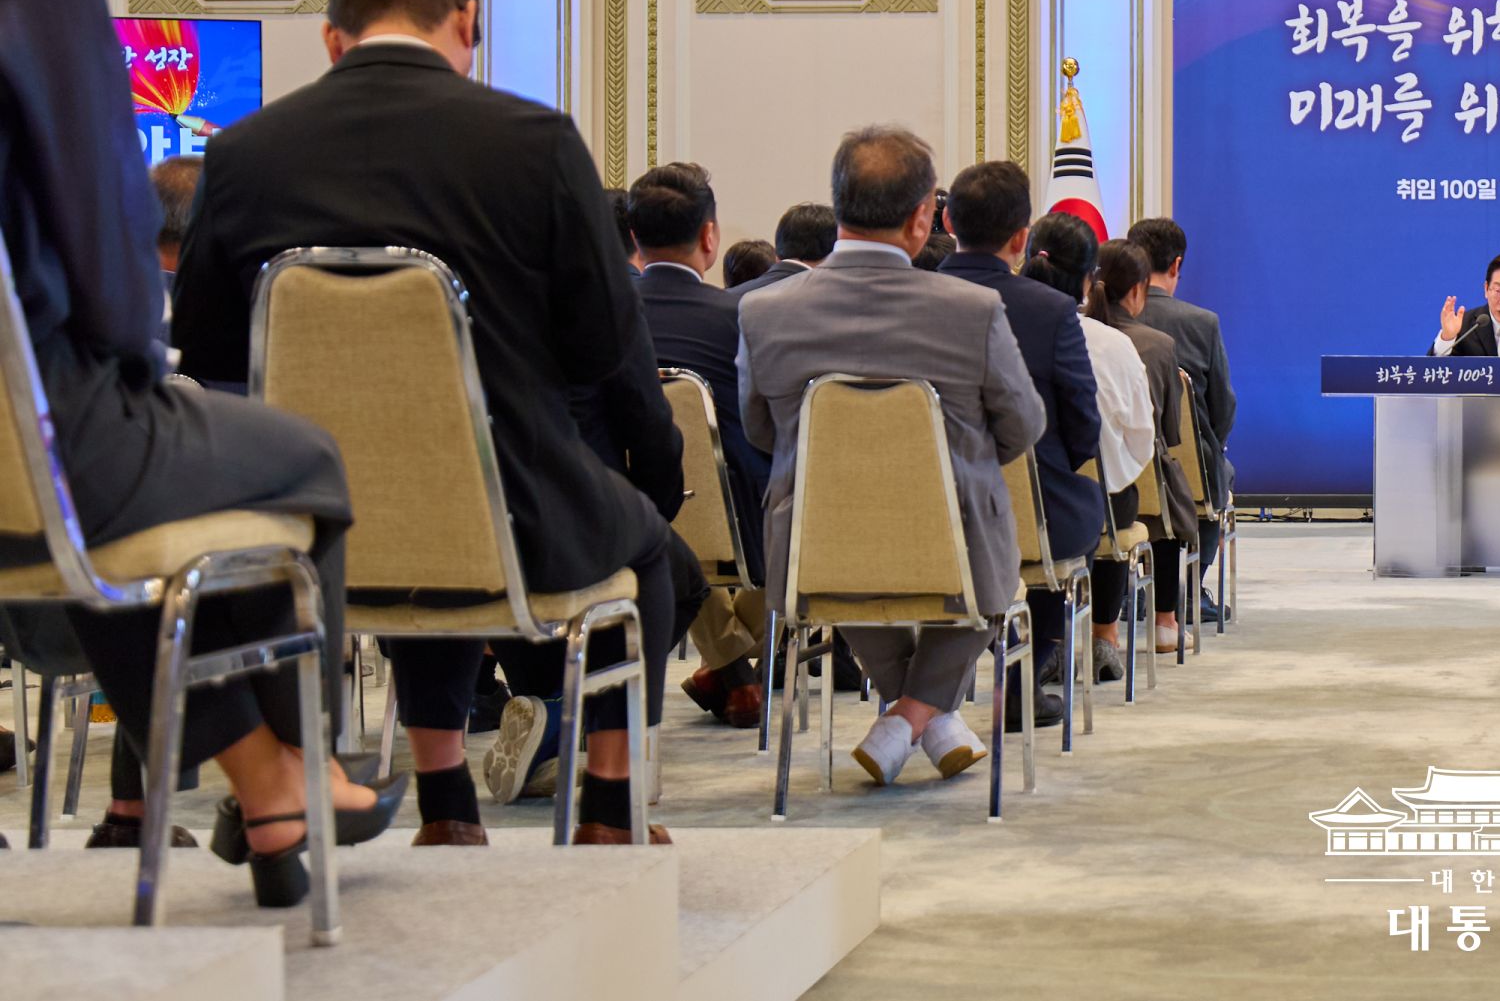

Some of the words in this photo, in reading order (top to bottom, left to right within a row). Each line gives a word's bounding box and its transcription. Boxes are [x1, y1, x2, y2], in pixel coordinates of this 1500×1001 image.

[144, 47, 193, 71] 성장
[1289, 72, 1433, 143] 미래를
[1396, 178, 1436, 200] 취임
[1439, 178, 1497, 200] 100일
[1375, 365, 1417, 385] 회복을
[1422, 366, 1453, 385] 위한
[1457, 365, 1493, 386] 100일
